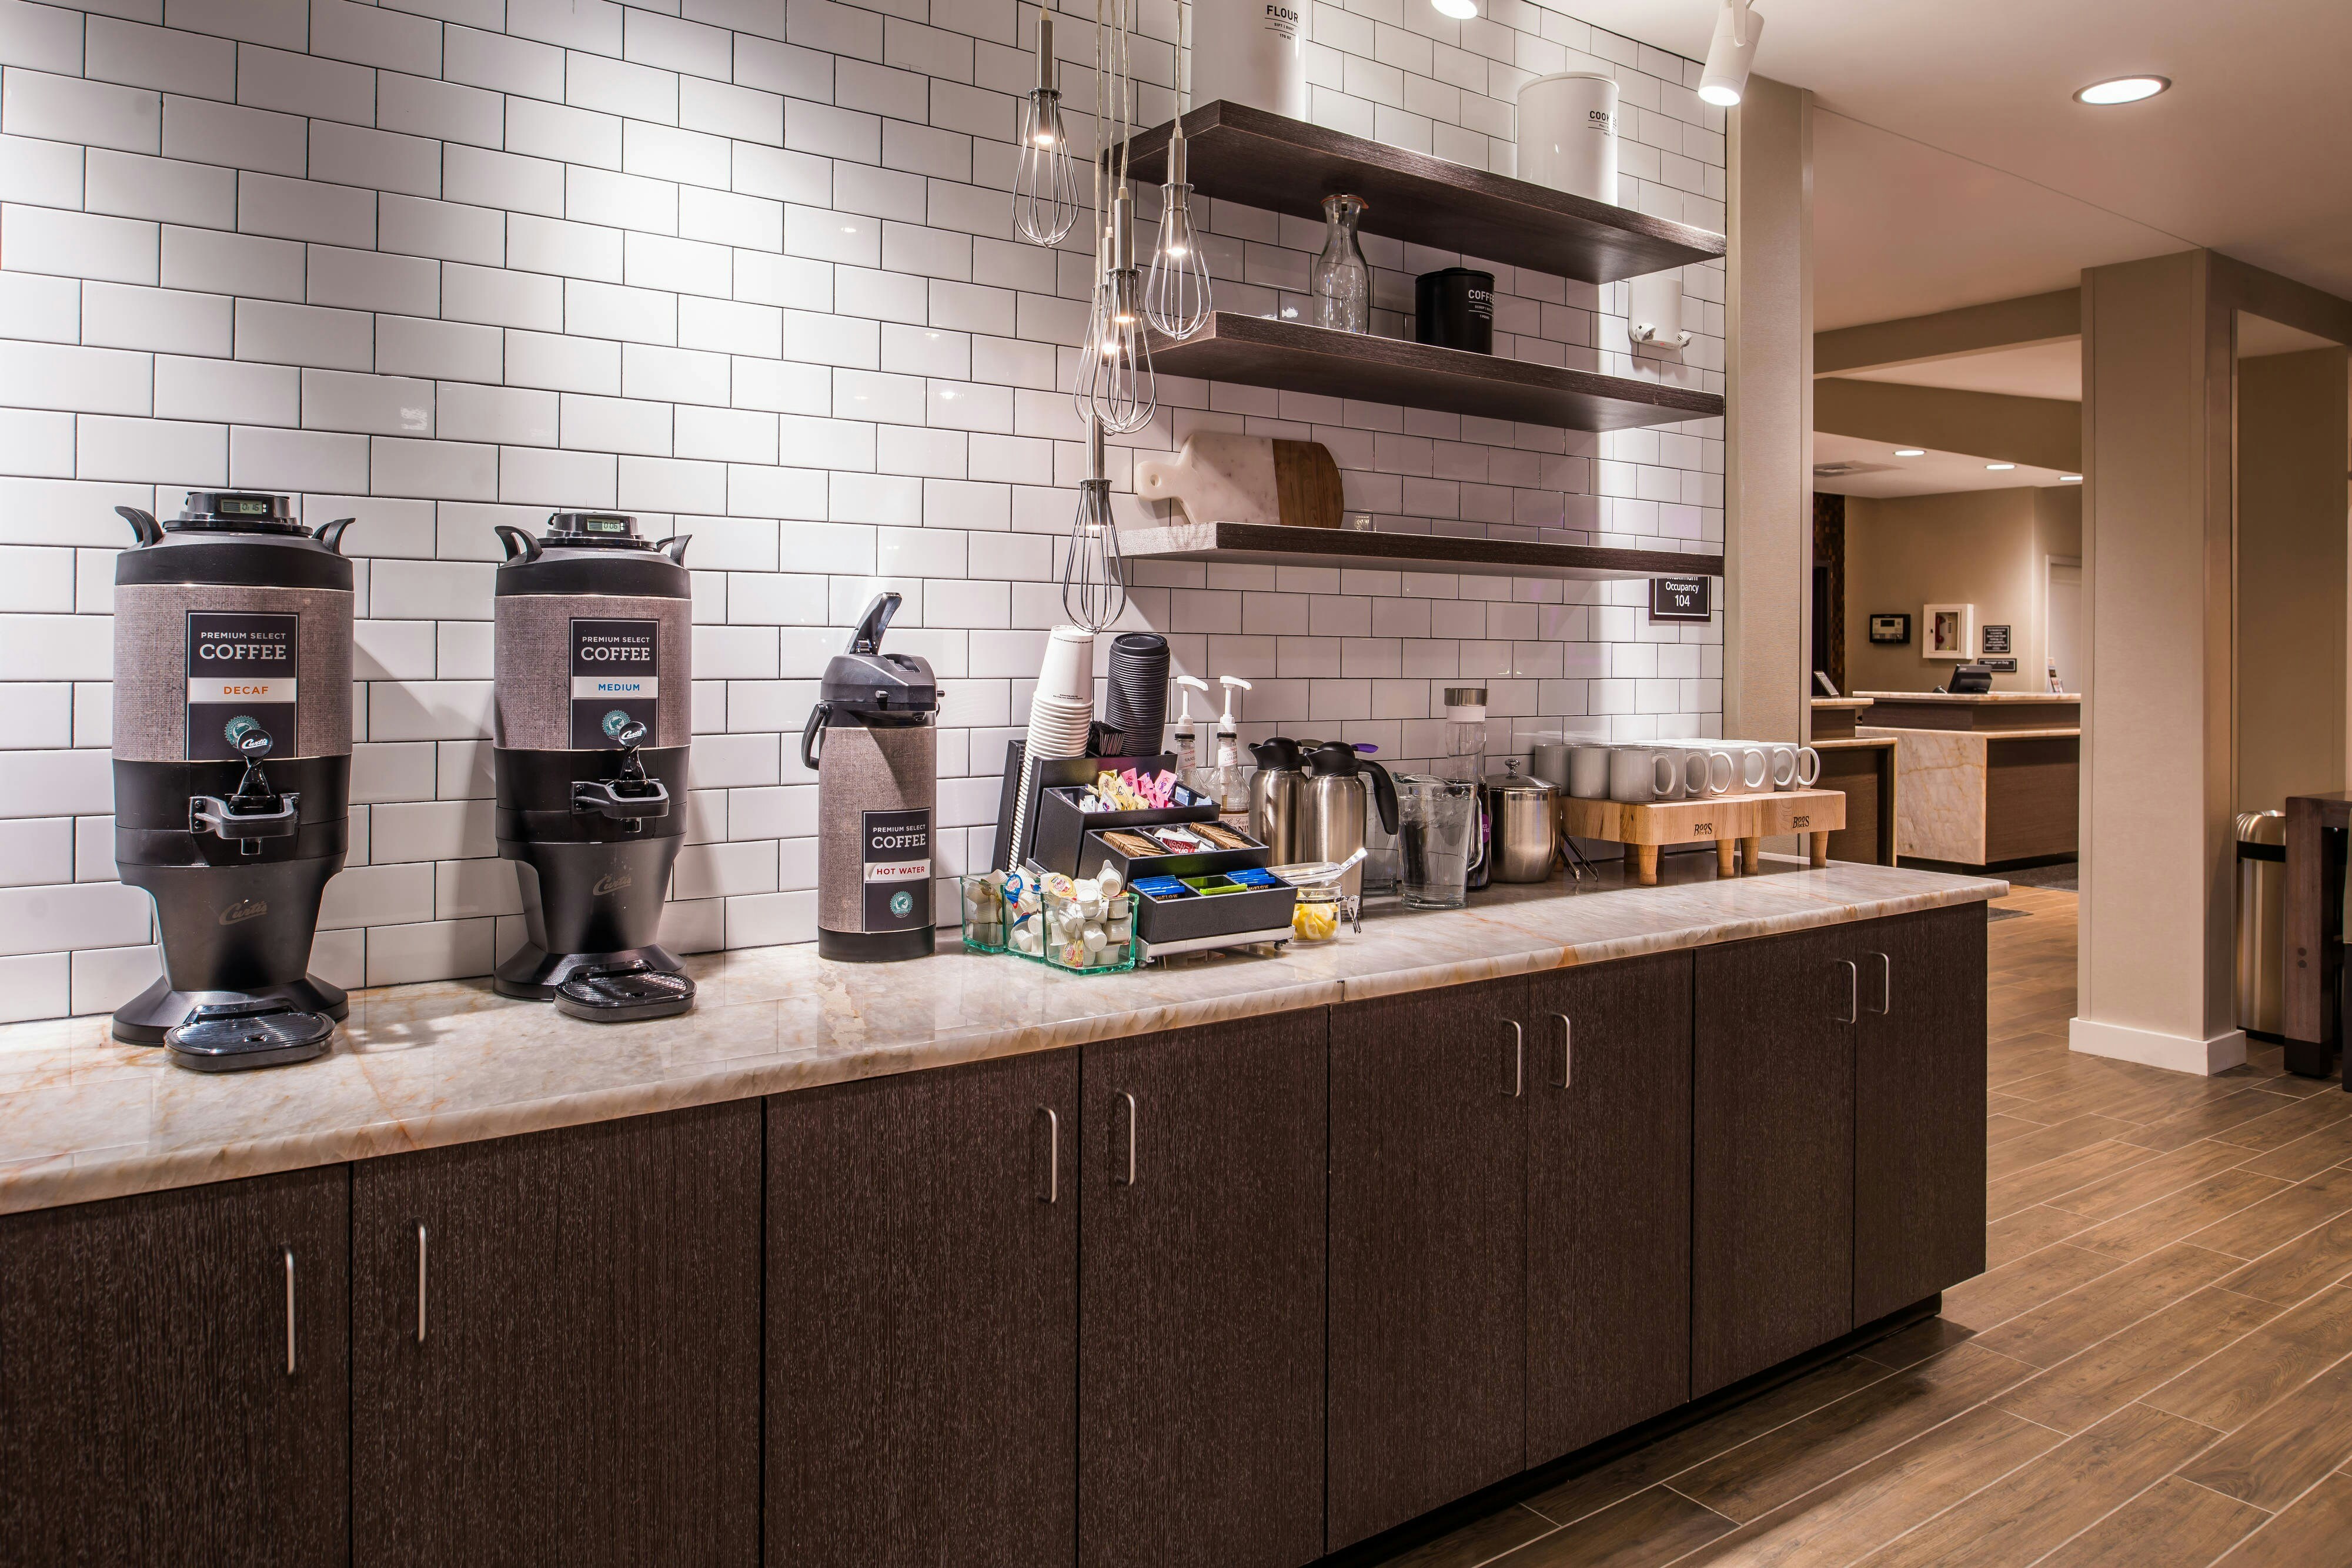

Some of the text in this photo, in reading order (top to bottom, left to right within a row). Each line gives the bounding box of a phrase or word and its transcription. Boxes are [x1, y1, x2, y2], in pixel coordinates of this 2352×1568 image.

[1267, 5, 1298, 24] FLOUR
[1666, 581, 1699, 594] Occupancy
[1675, 594, 1690, 607] 104
[199, 644, 286, 660] COFFEE
[581, 647, 650, 661] COFFEE
[224, 686, 269, 694] DECAF
[872, 834, 926, 849] COFFEE
[899, 866, 925, 874] WATER
[219, 901, 269, 925] Curtis
